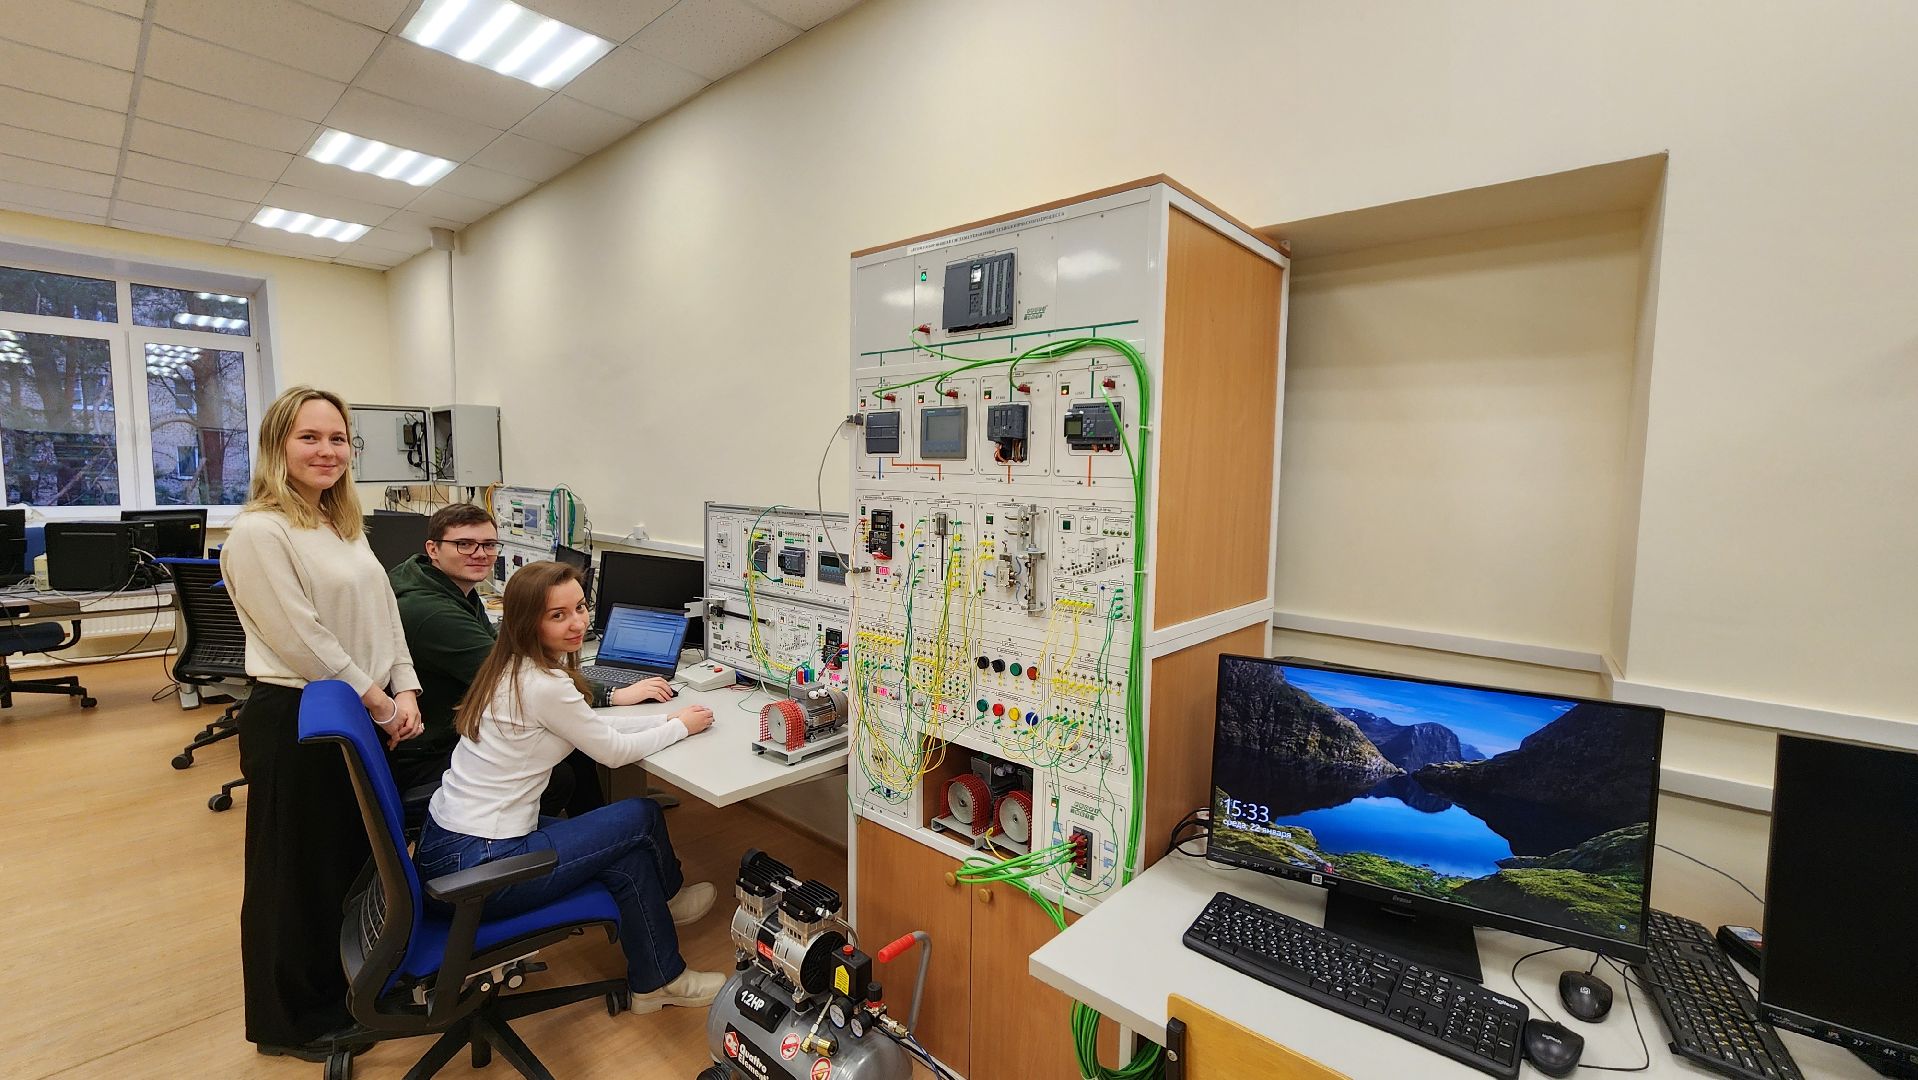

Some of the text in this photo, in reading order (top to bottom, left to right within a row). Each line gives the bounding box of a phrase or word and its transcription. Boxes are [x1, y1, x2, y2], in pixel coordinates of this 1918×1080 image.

[1224, 798, 1269, 823] 15:33
[1222, 818, 1292, 839] среда, 22 января
[740, 990, 766, 1012] 1.2HP
[1492, 996, 1519, 1010] logitech
[1541, 1033, 1562, 1044] logitech
[739, 1043, 768, 1074] Quattro
[1883, 1048, 1898, 1057] 4K
